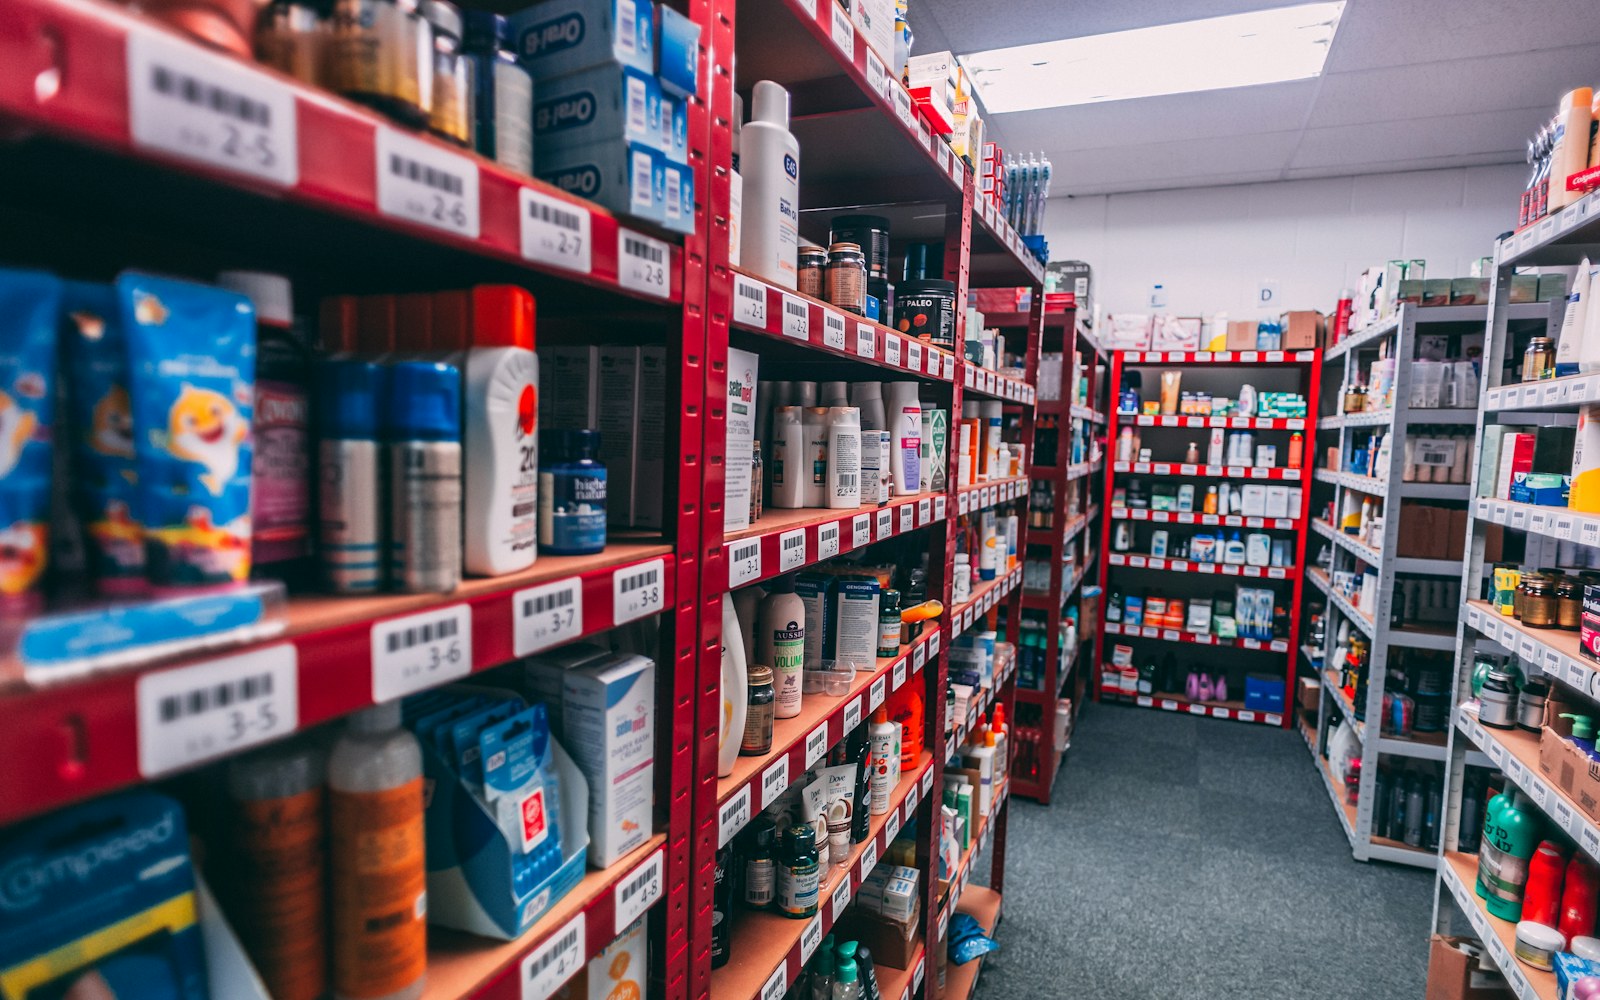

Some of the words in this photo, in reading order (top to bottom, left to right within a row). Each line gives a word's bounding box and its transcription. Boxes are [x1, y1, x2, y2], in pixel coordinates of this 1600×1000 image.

[222, 126, 276, 168] 2-5
[786, 157, 796, 176] E45
[432, 197, 467, 227] 2-6
[780, 202, 791, 217] Bath
[558, 231, 582, 257] 2-7
[645, 264, 664, 286] 2-8
[907, 299, 932, 307] PALEO
[1261, 288, 1272, 302] D
[752, 303, 763, 319] 2-1
[797, 319, 807, 333] 2-2
[835, 331, 844, 345] 2-3
[830, 539, 838, 552] 3-3
[794, 547, 804, 562] 3-2
[747, 558, 758, 574] 3-1
[641, 587, 659, 607] 3-8
[551, 608, 575, 633] 3-7
[428, 640, 462, 671] 3-6
[226, 703, 278, 741] 3-5
[634, 733, 650, 745] RASH
[816, 741, 825, 755] 4-3
[775, 776, 785, 791] 4-2
[829, 775, 846, 783] Dove
[735, 808, 746, 826] 4-1
[640, 879, 658, 904] 4-8
[812, 932, 820, 950] 5-3
[556, 945, 578, 976] 4-7
[774, 983, 784, 999] 5-2
